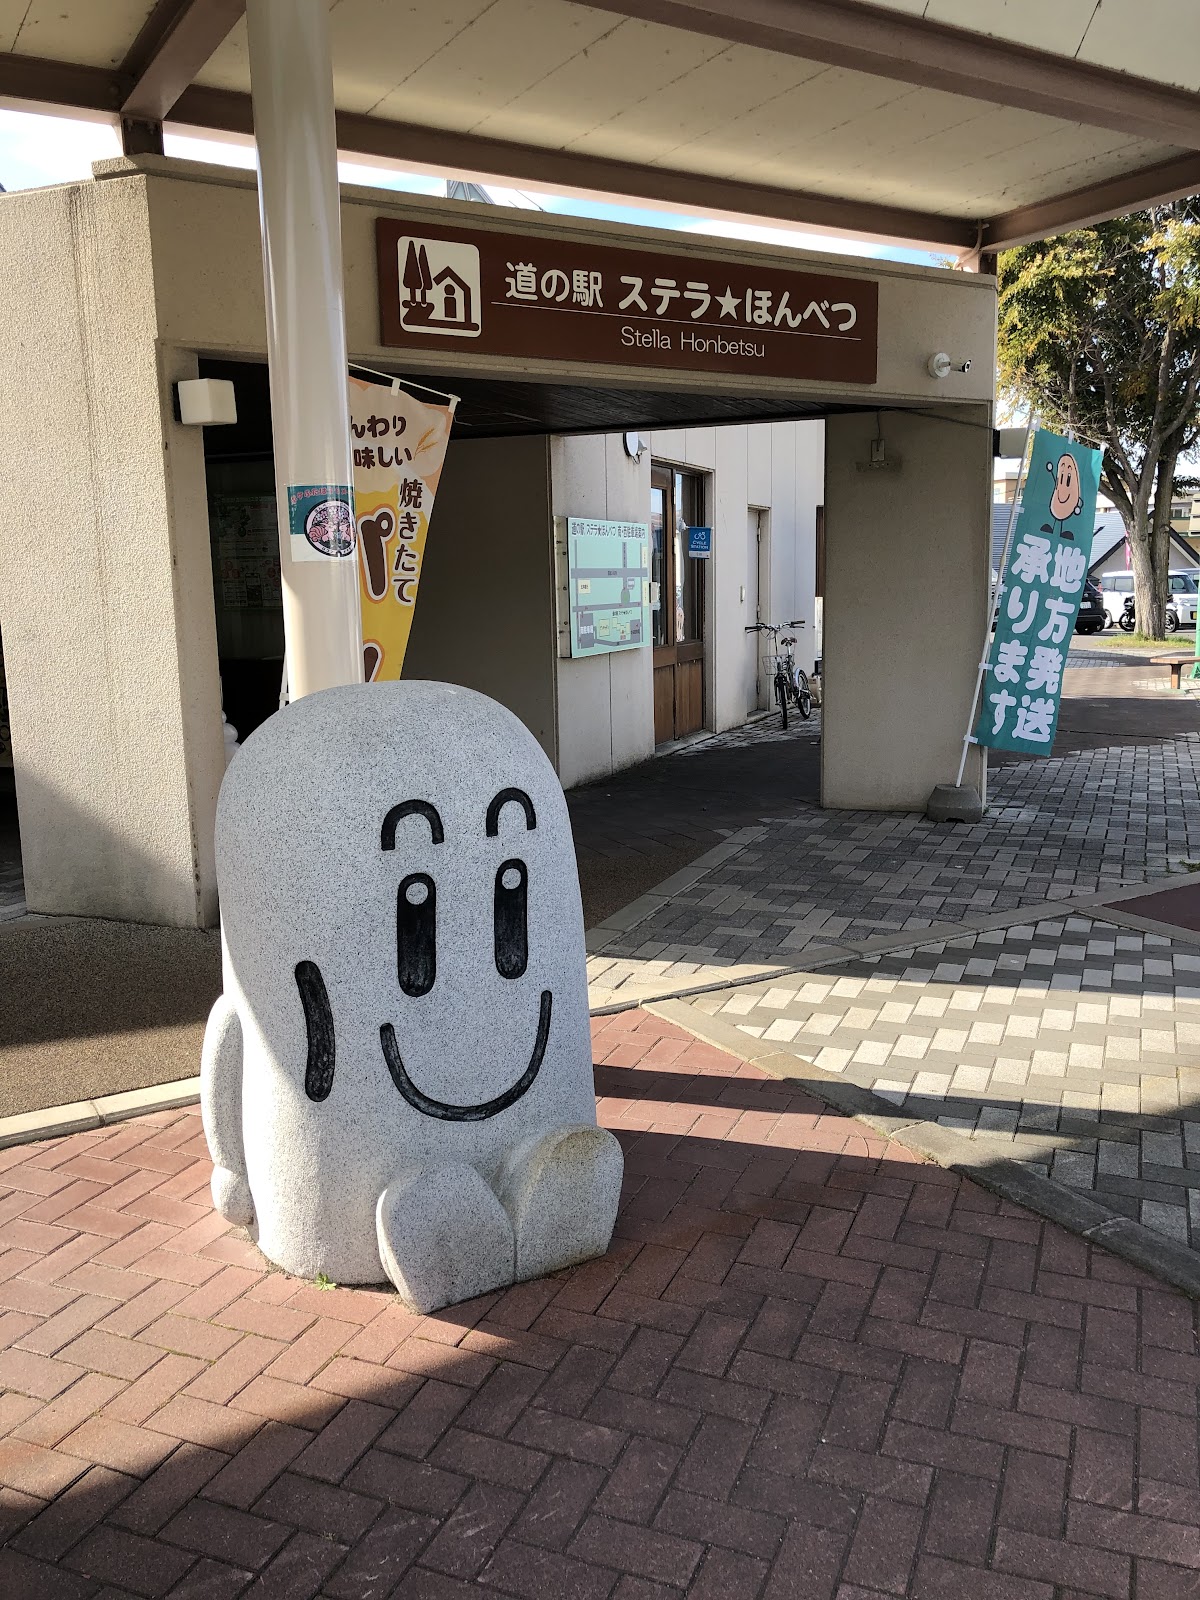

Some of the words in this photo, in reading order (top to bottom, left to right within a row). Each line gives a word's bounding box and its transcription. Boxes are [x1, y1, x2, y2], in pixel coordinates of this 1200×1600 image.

[505, 260, 604, 309] 道の駅
[619, 274, 857, 332] ステラ★ほんべつ
[621, 326, 672, 350] Stella
[680, 331, 765, 358] Honbetsu
[353, 446, 413, 470] 味しい
[393, 478, 424, 603] 焼きたて
[990, 534, 1052, 736] 承ります
[1011, 543, 1086, 743] 地方発送
